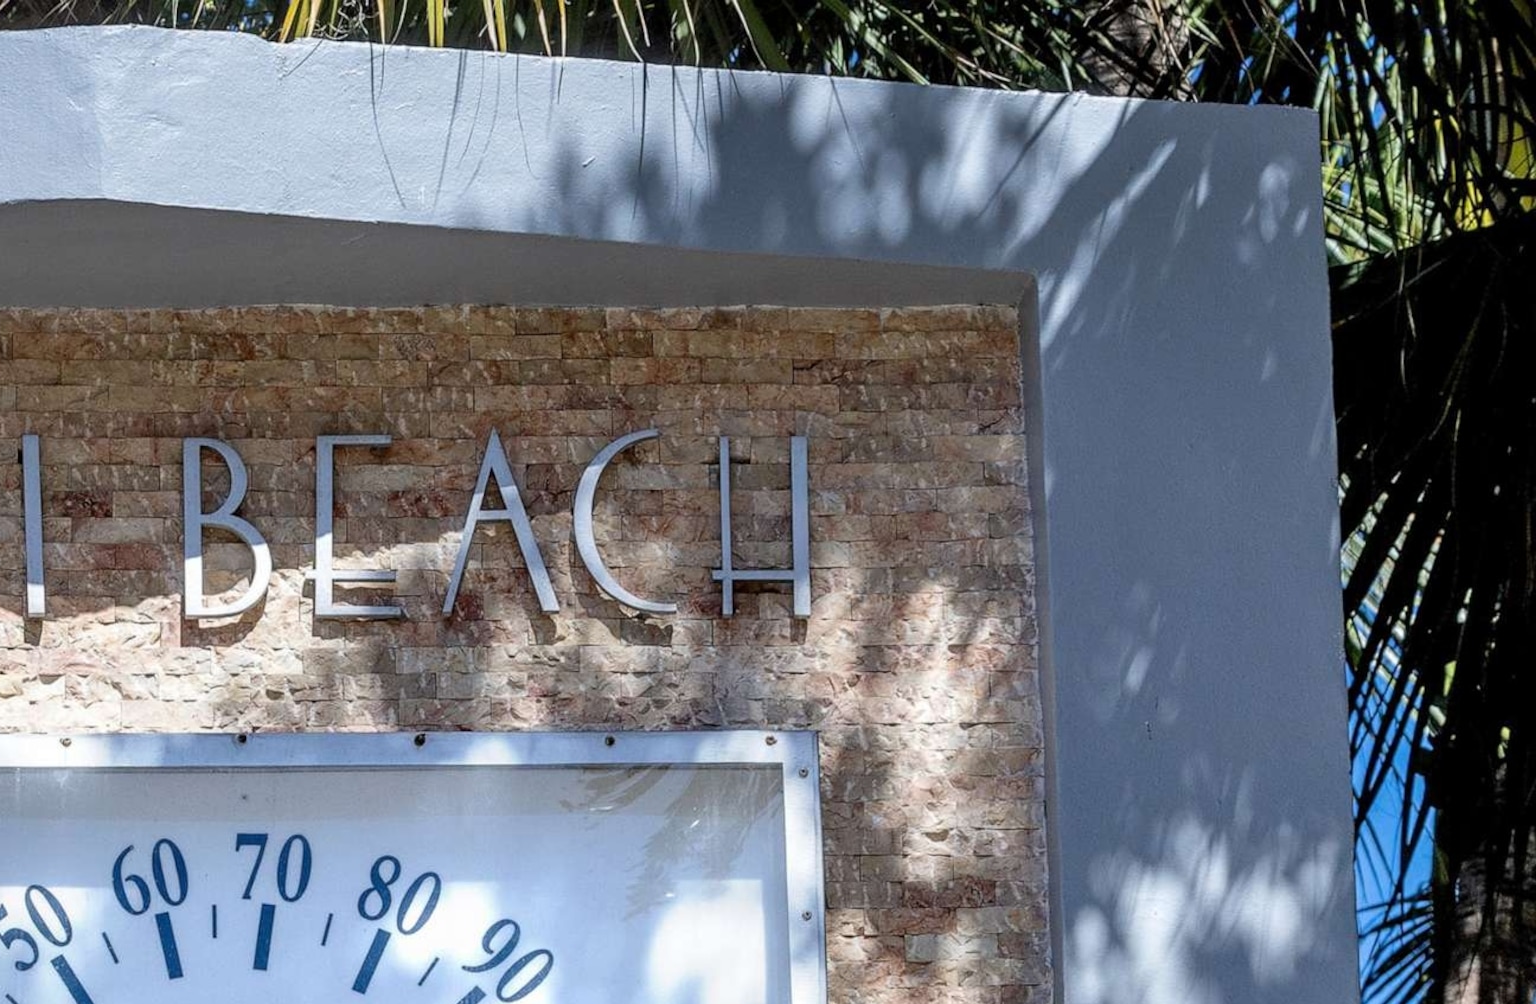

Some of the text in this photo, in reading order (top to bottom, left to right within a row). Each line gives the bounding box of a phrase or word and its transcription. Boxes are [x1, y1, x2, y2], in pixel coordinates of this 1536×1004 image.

[182, 427, 811, 618] BEACH
[112, 838, 190, 915] 60
[235, 833, 313, 902] 70
[357, 855, 442, 935] 80
[462, 919, 554, 1004] 90
